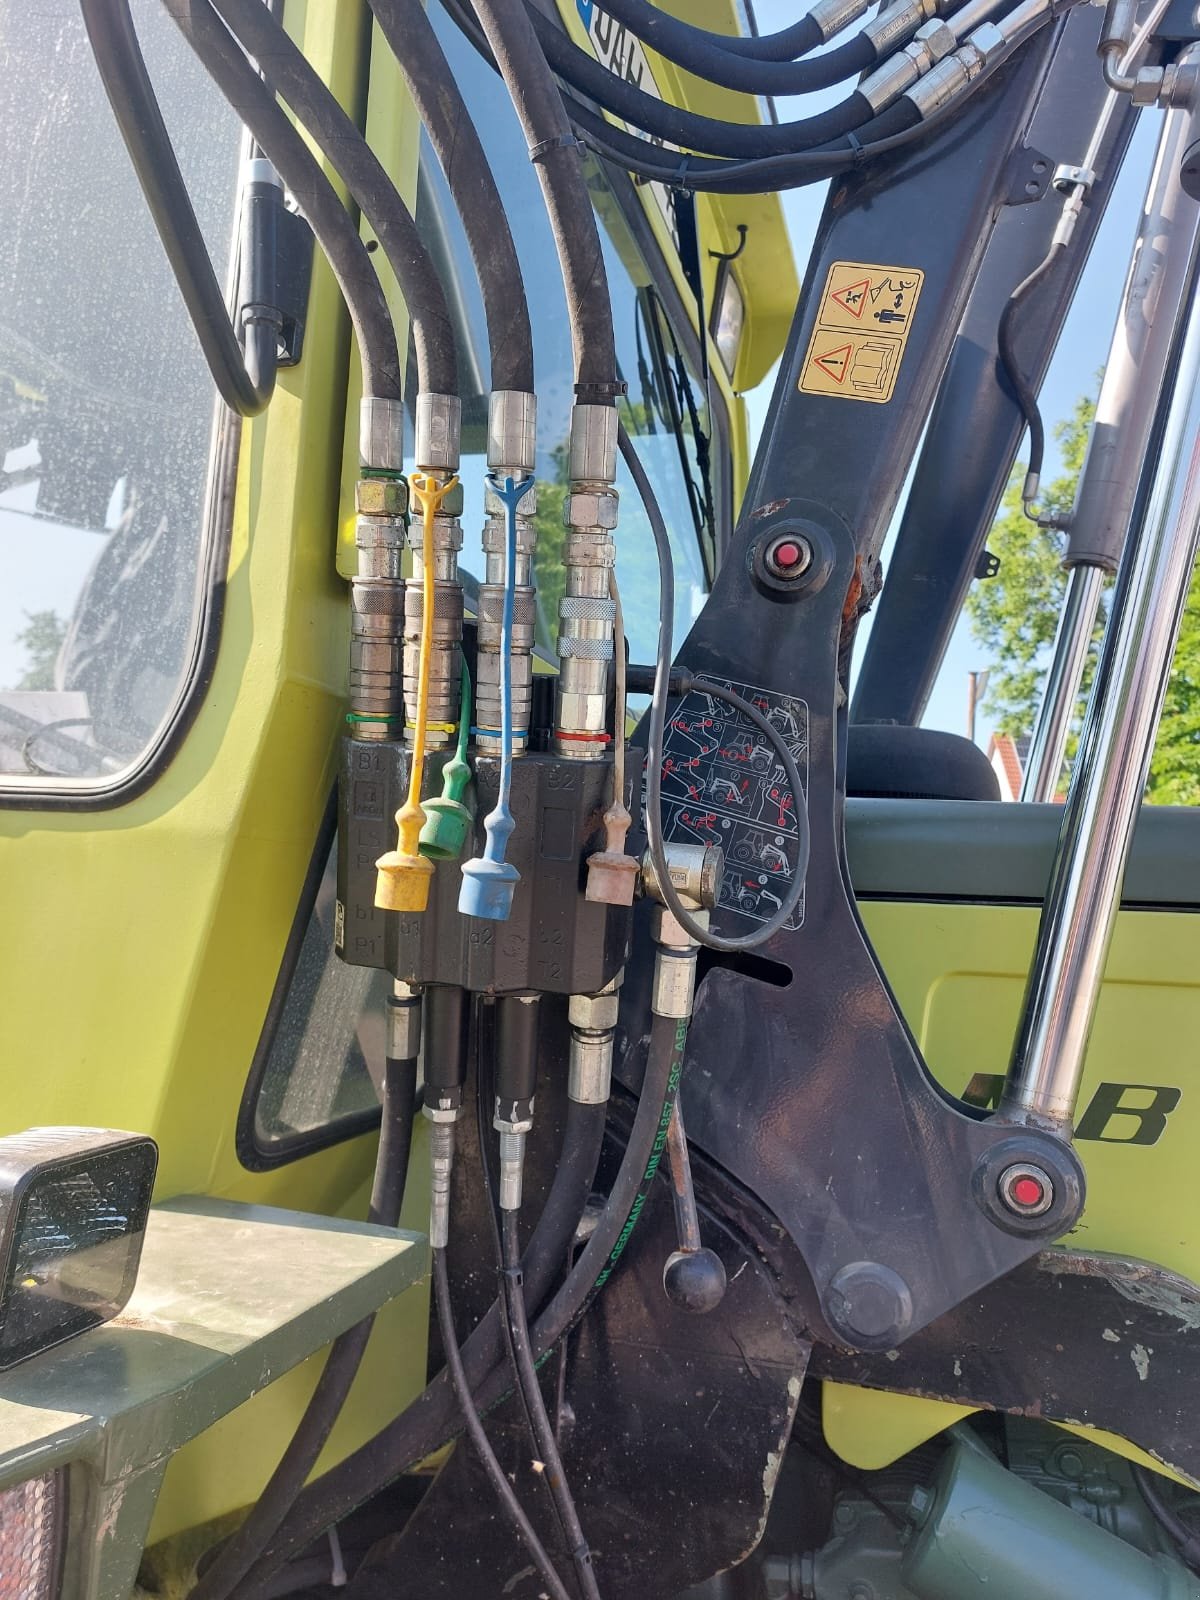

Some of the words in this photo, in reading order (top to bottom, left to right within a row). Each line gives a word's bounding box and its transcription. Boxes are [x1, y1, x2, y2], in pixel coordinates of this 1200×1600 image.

[611, 1193, 646, 1261] GERMANY
[644, 1154, 661, 1180] DIN
[653, 1131, 666, 1151] EN
[661, 1101, 674, 1127] 857
[668, 1061, 682, 1093] 2SC
